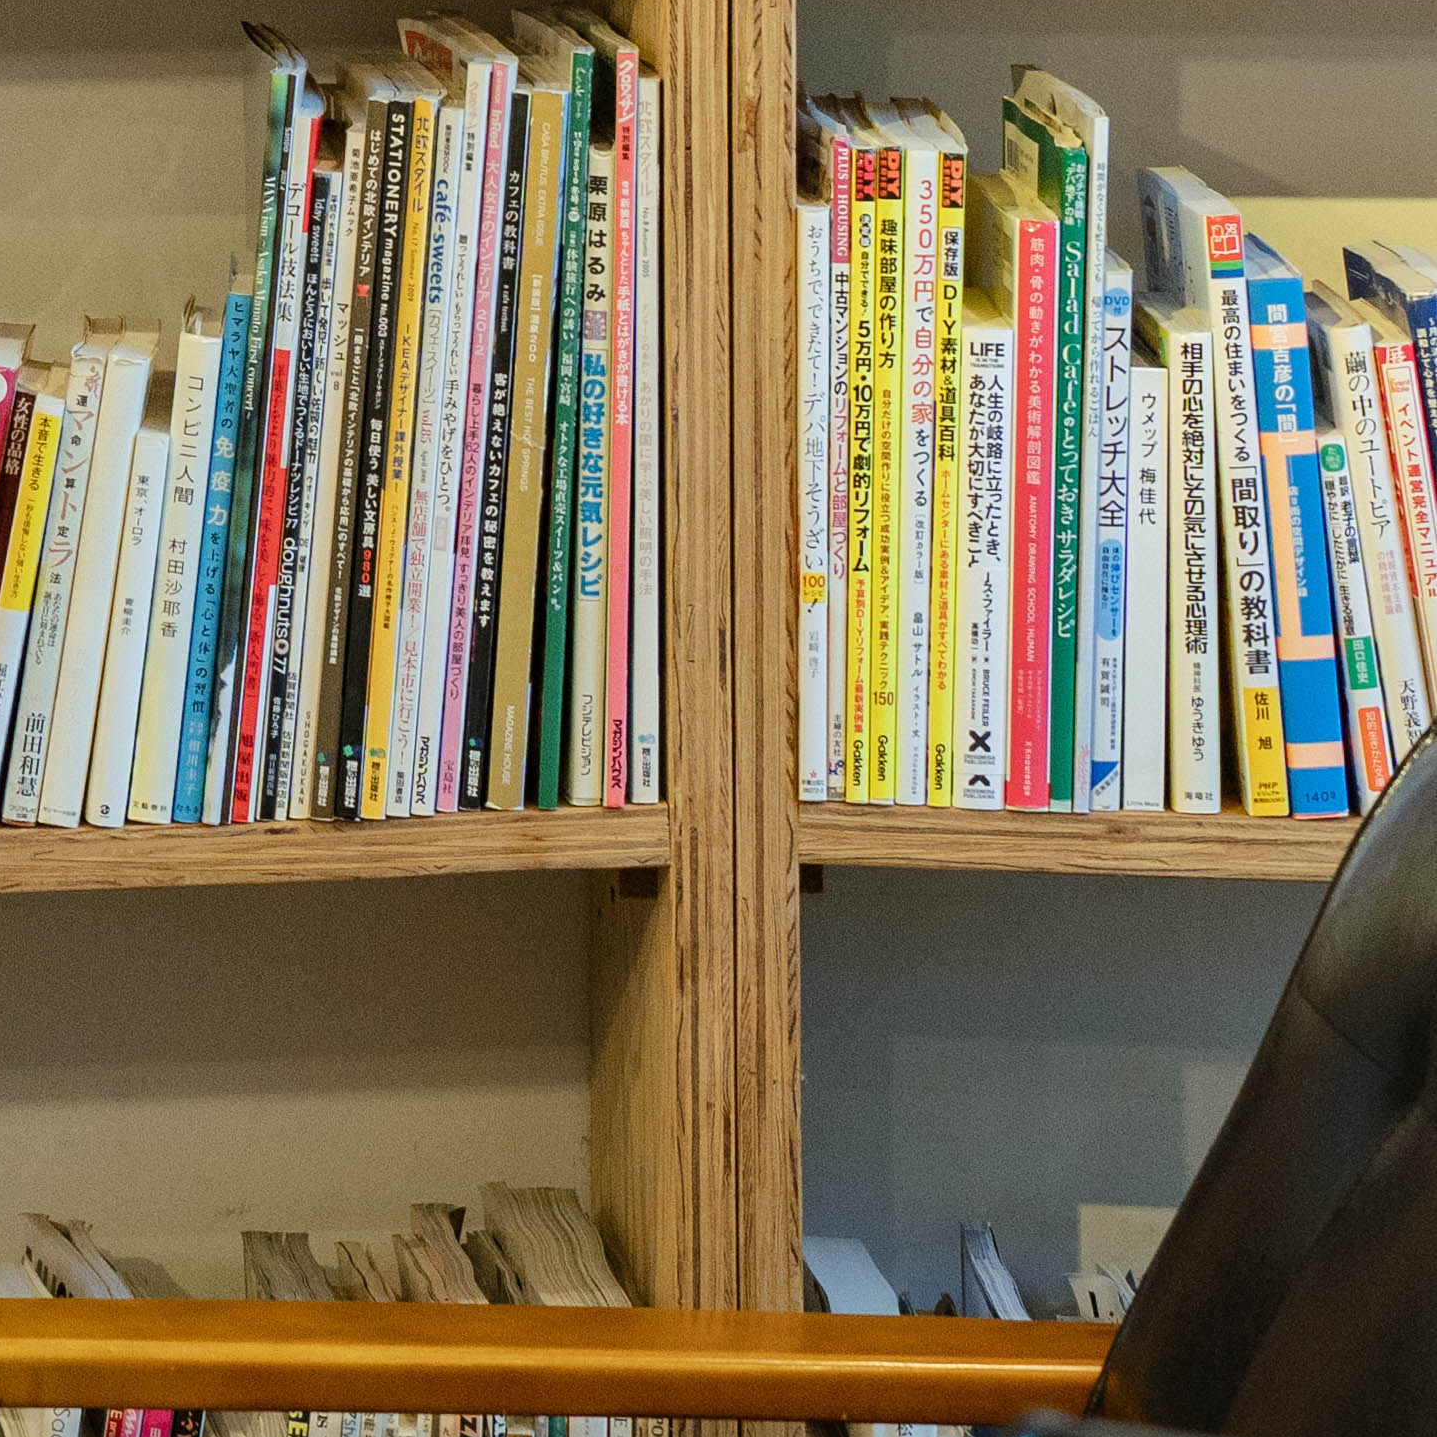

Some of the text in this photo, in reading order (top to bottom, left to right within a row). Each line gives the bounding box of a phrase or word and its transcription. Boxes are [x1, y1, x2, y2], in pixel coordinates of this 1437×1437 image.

[379, 113, 405, 302] STATIONERY magazine
[836, 196, 849, 258] HOUSING
[840, 147, 849, 181] PLUS
[585, 175, 608, 303] 栗原はるみ
[878, 218, 899, 370] 趣味部屋の作り方
[942, 231, 960, 277] 保存版
[969, 341, 1005, 358] LIFE
[1063, 241, 1082, 409] Salad Cafe
[1219, 288, 1252, 464] 最高の住まいをつくる
[172, 374, 205, 507] コンビニ人間
[206, 436, 236, 527] 免疫力
[1097, 326, 1129, 530] ストレッチ大全
[478, 372, 508, 628] 客が絶えないカフェの秘密を教えます
[1180, 342, 1209, 657] 相手の心を絶対にその気にさせる心理術
[801, 575, 825, 588] 100
